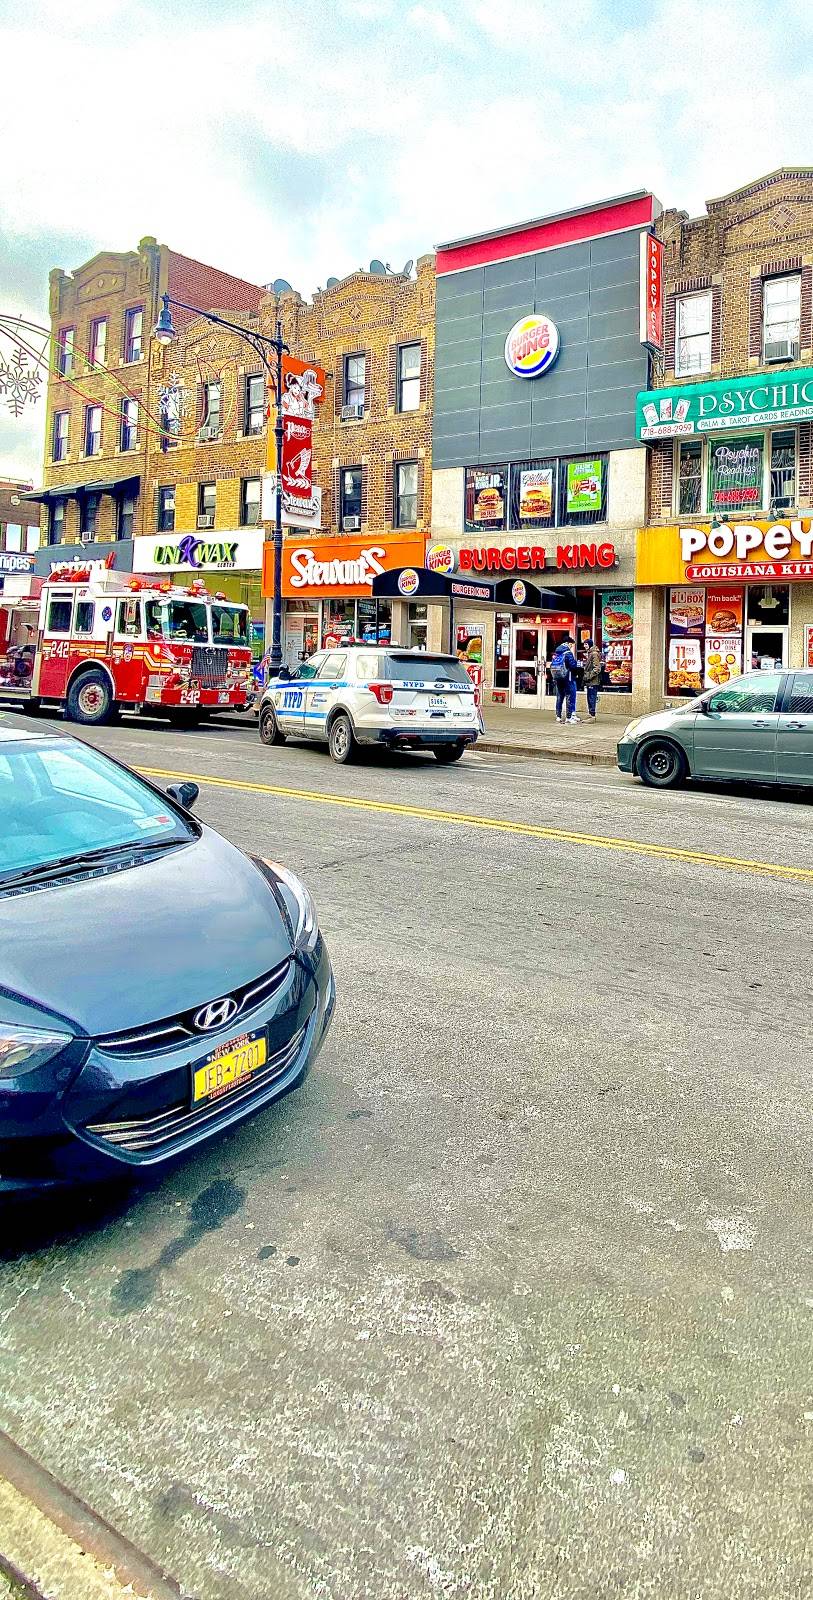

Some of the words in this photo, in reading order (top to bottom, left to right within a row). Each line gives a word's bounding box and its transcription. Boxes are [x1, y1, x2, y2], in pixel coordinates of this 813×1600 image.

[512, 324, 549, 351] BURGER
[513, 334, 550, 364] KING
[700, 419, 719, 428] PALM
[729, 414, 751, 424] TAROT
[754, 412, 778, 422] CARDS
[642, 424, 692, 437] 718-688-2959
[428, 549, 451, 561] BURGER
[459, 545, 546, 571] BURGER
[556, 542, 616, 569] KING
[428, 557, 452, 570] KING
[692, 563, 777, 578] LOUISIANA
[400, 578, 417, 588] KING
[452, 583, 474, 596] BURGER
[475, 587, 491, 598] KING
[687, 594, 704, 604] BOX
[50, 641, 70, 659] 242
[675, 646, 686, 659] 11
[180, 690, 201, 704] 242
[283, 691, 303, 709] NYPD
[211, 1048, 231, 1062] NEW
[231, 1038, 250, 1050] YORK
